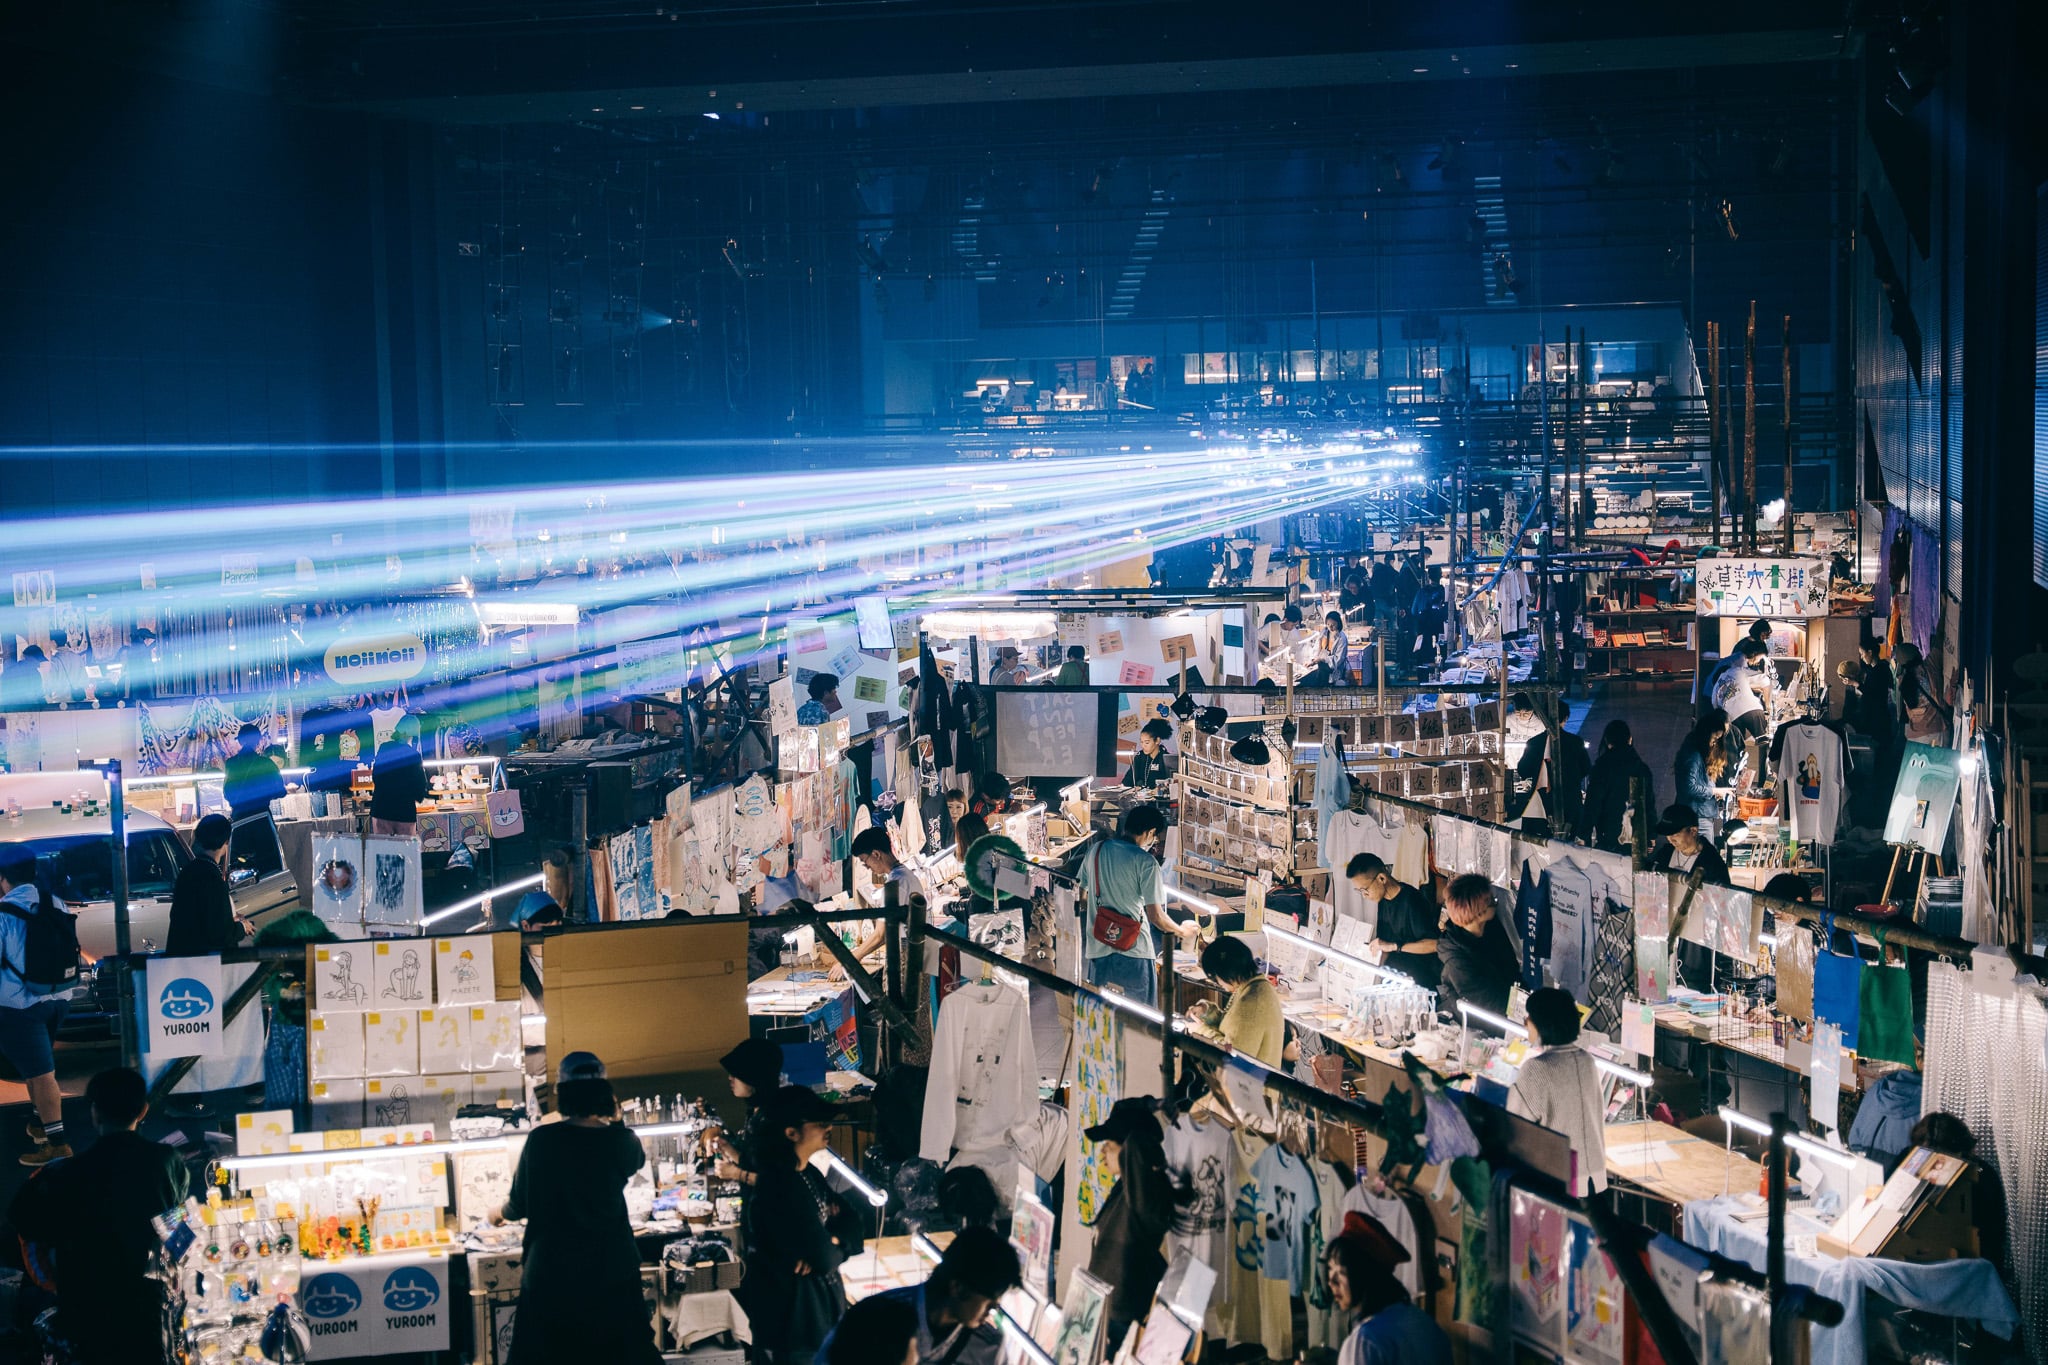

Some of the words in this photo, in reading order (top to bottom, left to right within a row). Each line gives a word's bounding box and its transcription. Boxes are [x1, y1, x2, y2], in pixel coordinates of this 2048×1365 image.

[163, 1021, 210, 1037] YUROOM
[309, 1319, 358, 1337] YUROOM
[385, 1313, 436, 1330] YUROOM
